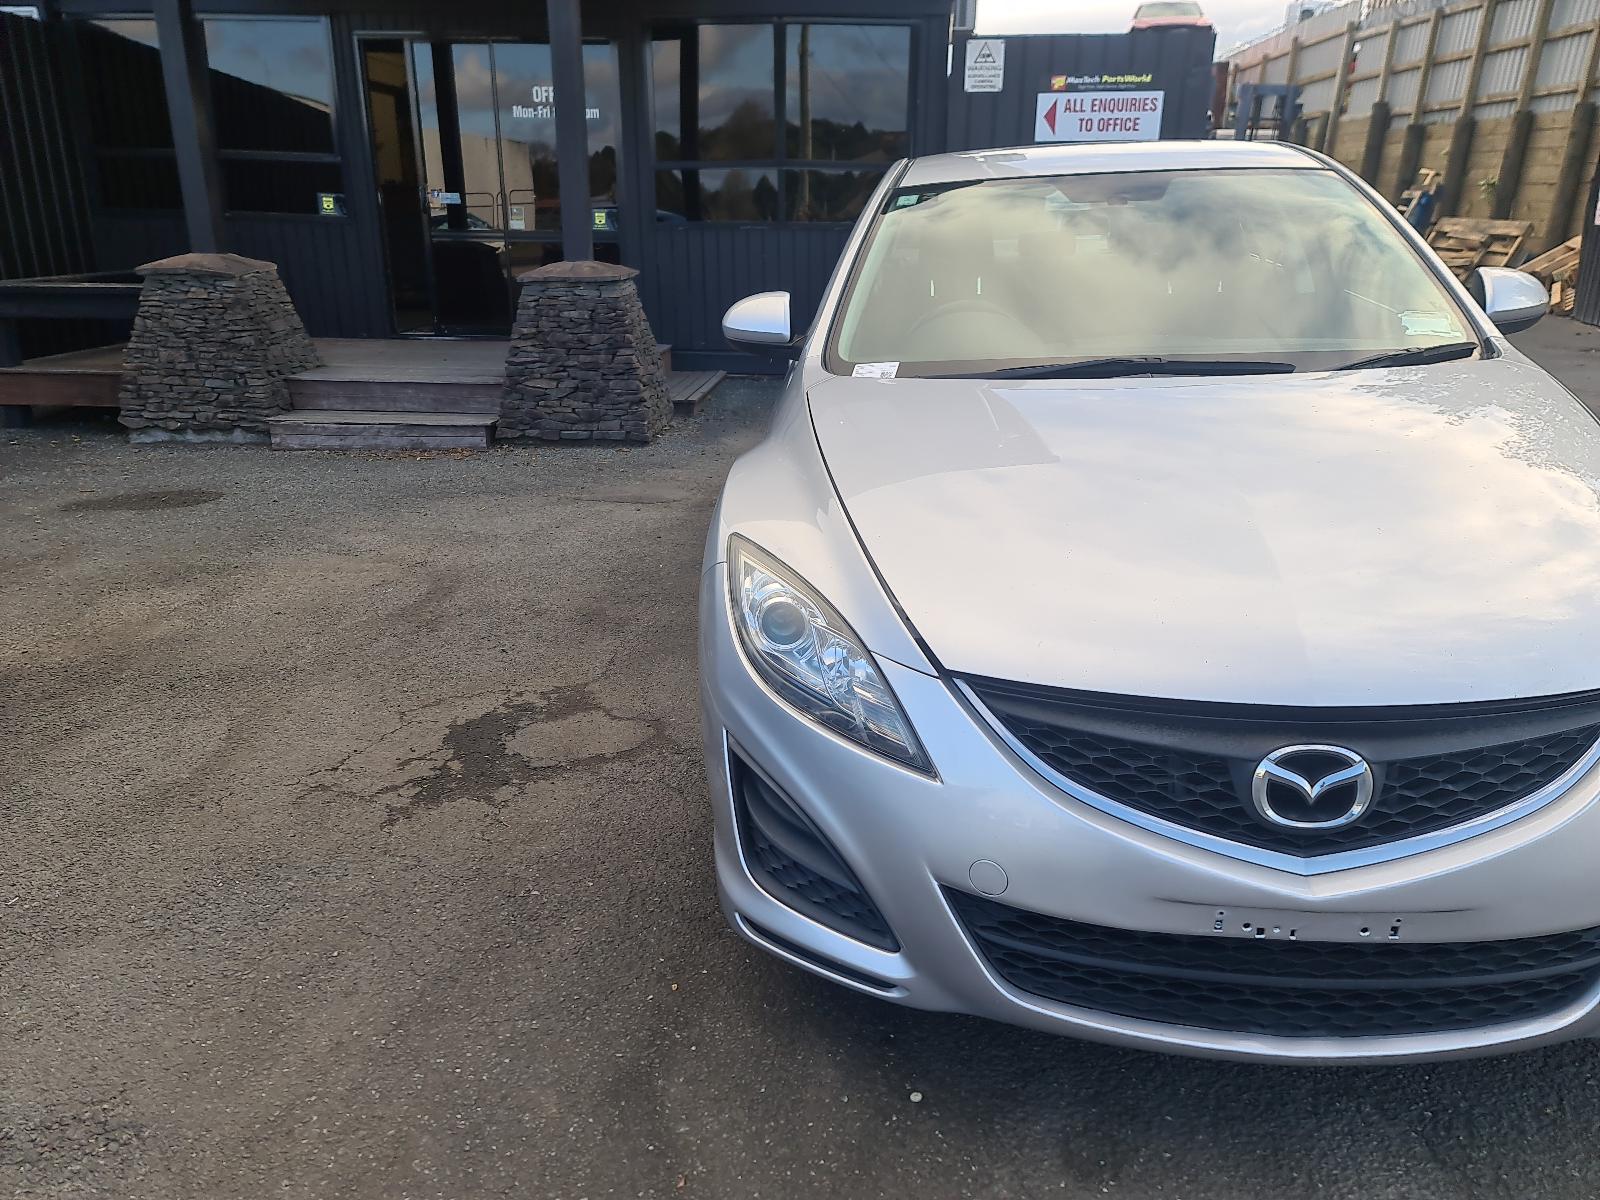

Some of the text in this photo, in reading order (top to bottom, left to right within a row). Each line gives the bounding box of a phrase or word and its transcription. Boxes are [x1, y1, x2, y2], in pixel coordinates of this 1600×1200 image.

[1102, 74, 1152, 84] PartsWorld
[532, 86, 555, 103] OFF
[512, 105, 551, 119] Mon-Fri
[1064, 97, 1158, 114] ALL ENQUIRIES
[1078, 117, 1140, 132] TO OFFICE
